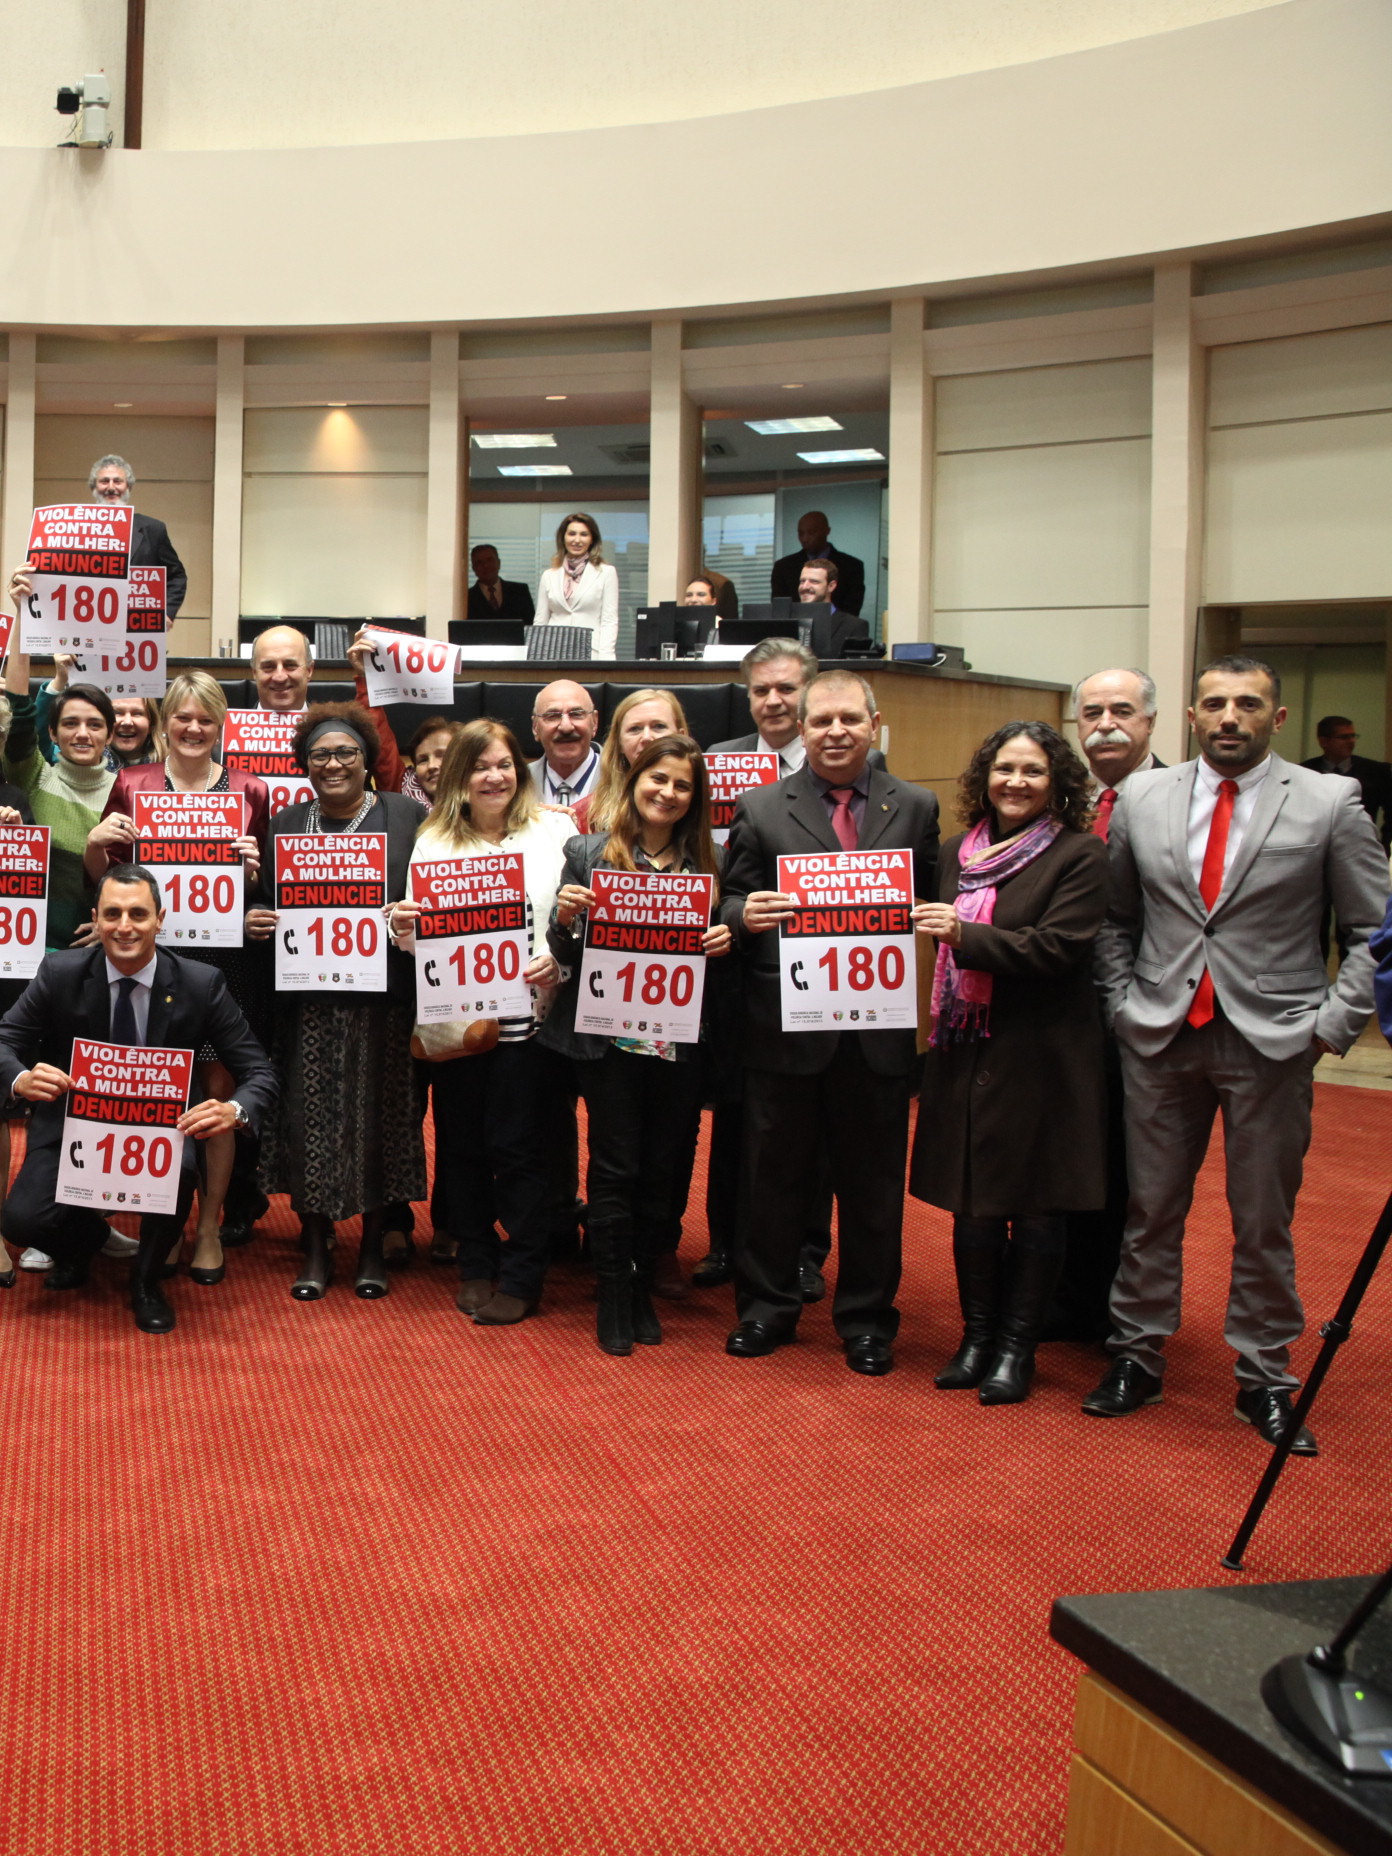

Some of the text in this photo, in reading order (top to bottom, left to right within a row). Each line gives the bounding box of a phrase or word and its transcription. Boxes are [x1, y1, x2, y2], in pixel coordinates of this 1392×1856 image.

[38, 506, 127, 522] VIOLÊNCIA
[44, 522, 115, 536] CONTRA
[32, 536, 125, 552] A MULHER:
[30, 552, 125, 575] DENUNCIE!
[51, 584, 119, 624] 180
[386, 641, 449, 674] 180
[227, 740, 240, 751] A
[140, 794, 238, 808] VIOLÊNCIA
[151, 811, 226, 823] CONTRA
[140, 825, 238, 838] A MULHER:
[281, 835, 380, 851] VIOLÊNCIA
[293, 853, 369, 866] CONTRA
[416, 856, 519, 879] VIOLÊNCIA
[784, 854, 905, 874] VIOLÊNCIA
[281, 867, 381, 881] A MULHER:
[430, 873, 508, 894] CONTRA
[598, 874, 706, 893] VIOLÊNCIA
[799, 872, 891, 889] CONTRA
[165, 874, 235, 913] 180
[281, 886, 382, 906] DENUNCIE!
[421, 888, 520, 910] A MULHER:
[609, 892, 692, 909] CONTRA
[789, 888, 907, 906] A MULHER:
[421, 906, 522, 936] DENUNCIE!
[594, 907, 704, 926] A MULHER:
[787, 908, 908, 934] DENUNCIE!
[308, 917, 378, 957] 180
[592, 925, 704, 951] DENUNCIE!
[449, 940, 520, 986] 180
[819, 945, 905, 991] 180
[616, 961, 695, 1007] 180
[80, 1043, 185, 1067] VIOLÊNCIA
[90, 1063, 171, 1082] CONTRA
[75, 1076, 183, 1099] A MULHER:
[72, 1095, 182, 1124] DENUNCIE!
[96, 1133, 172, 1178] 180
